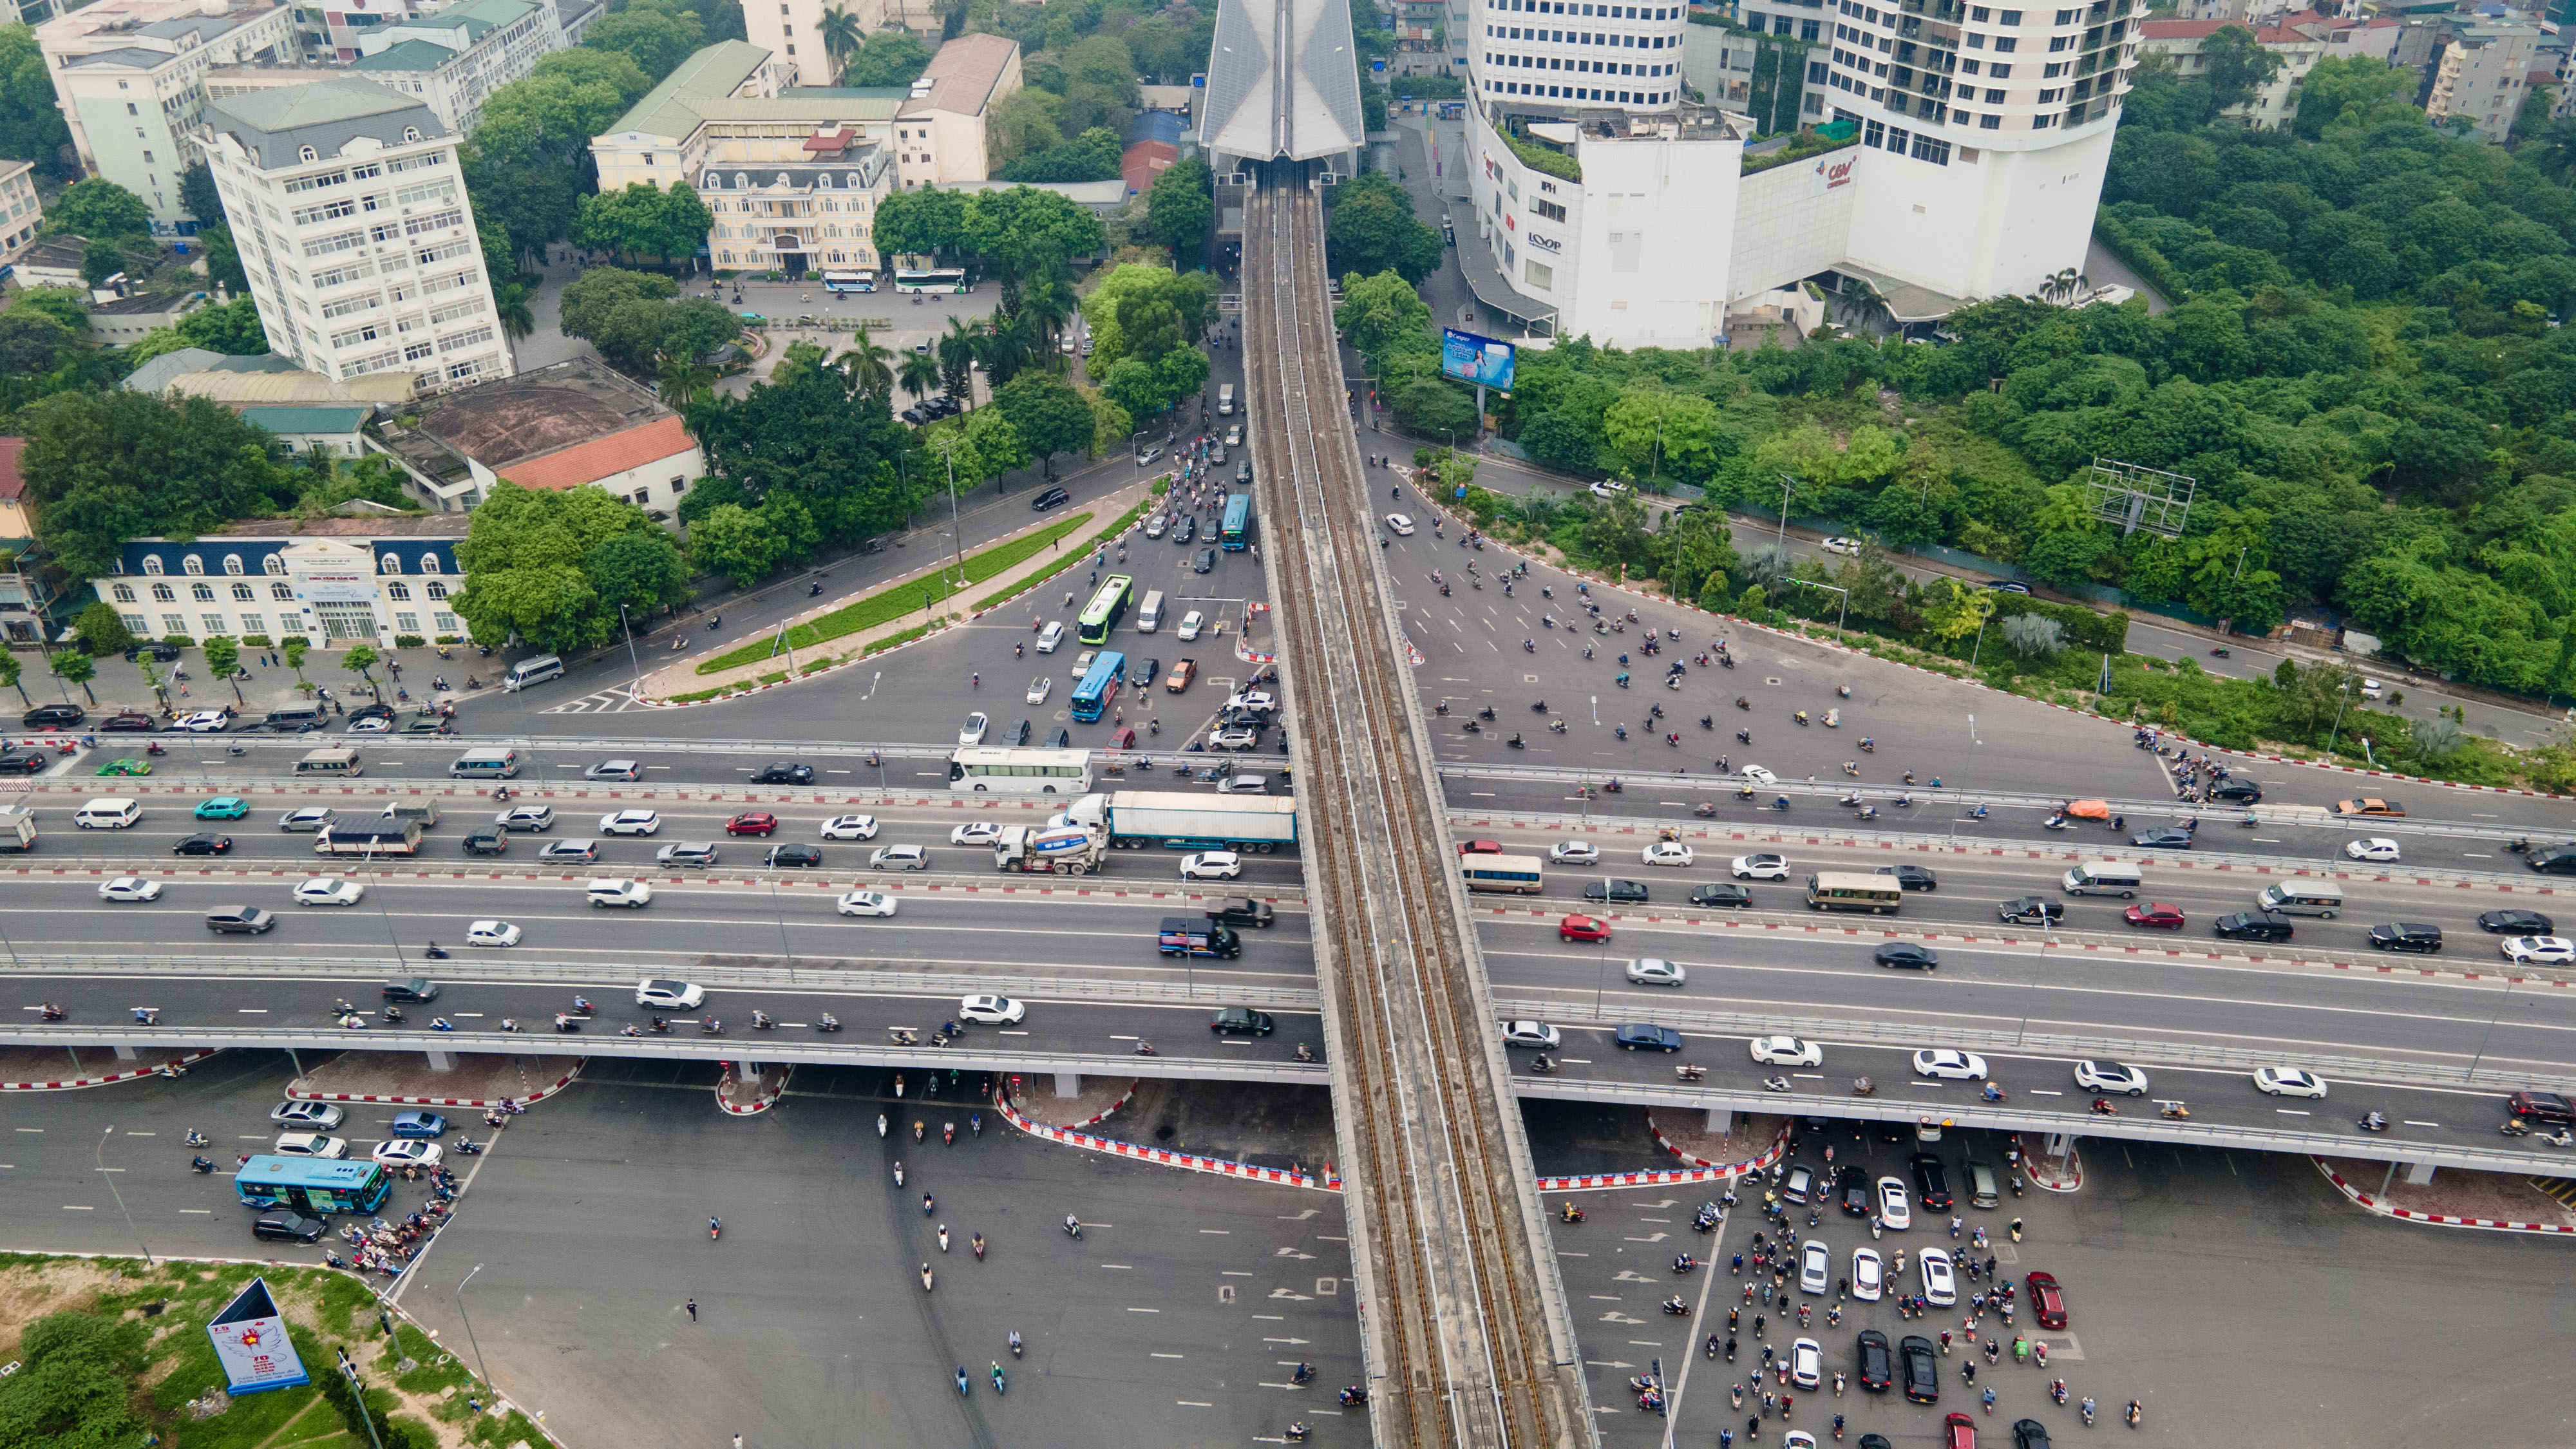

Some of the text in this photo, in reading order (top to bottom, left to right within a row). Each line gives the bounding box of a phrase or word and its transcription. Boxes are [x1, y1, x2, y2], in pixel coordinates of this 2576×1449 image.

[1828, 161, 1853, 180] CGV
[1528, 232, 1562, 250] LOOP
[1453, 333, 1471, 341] Casper
